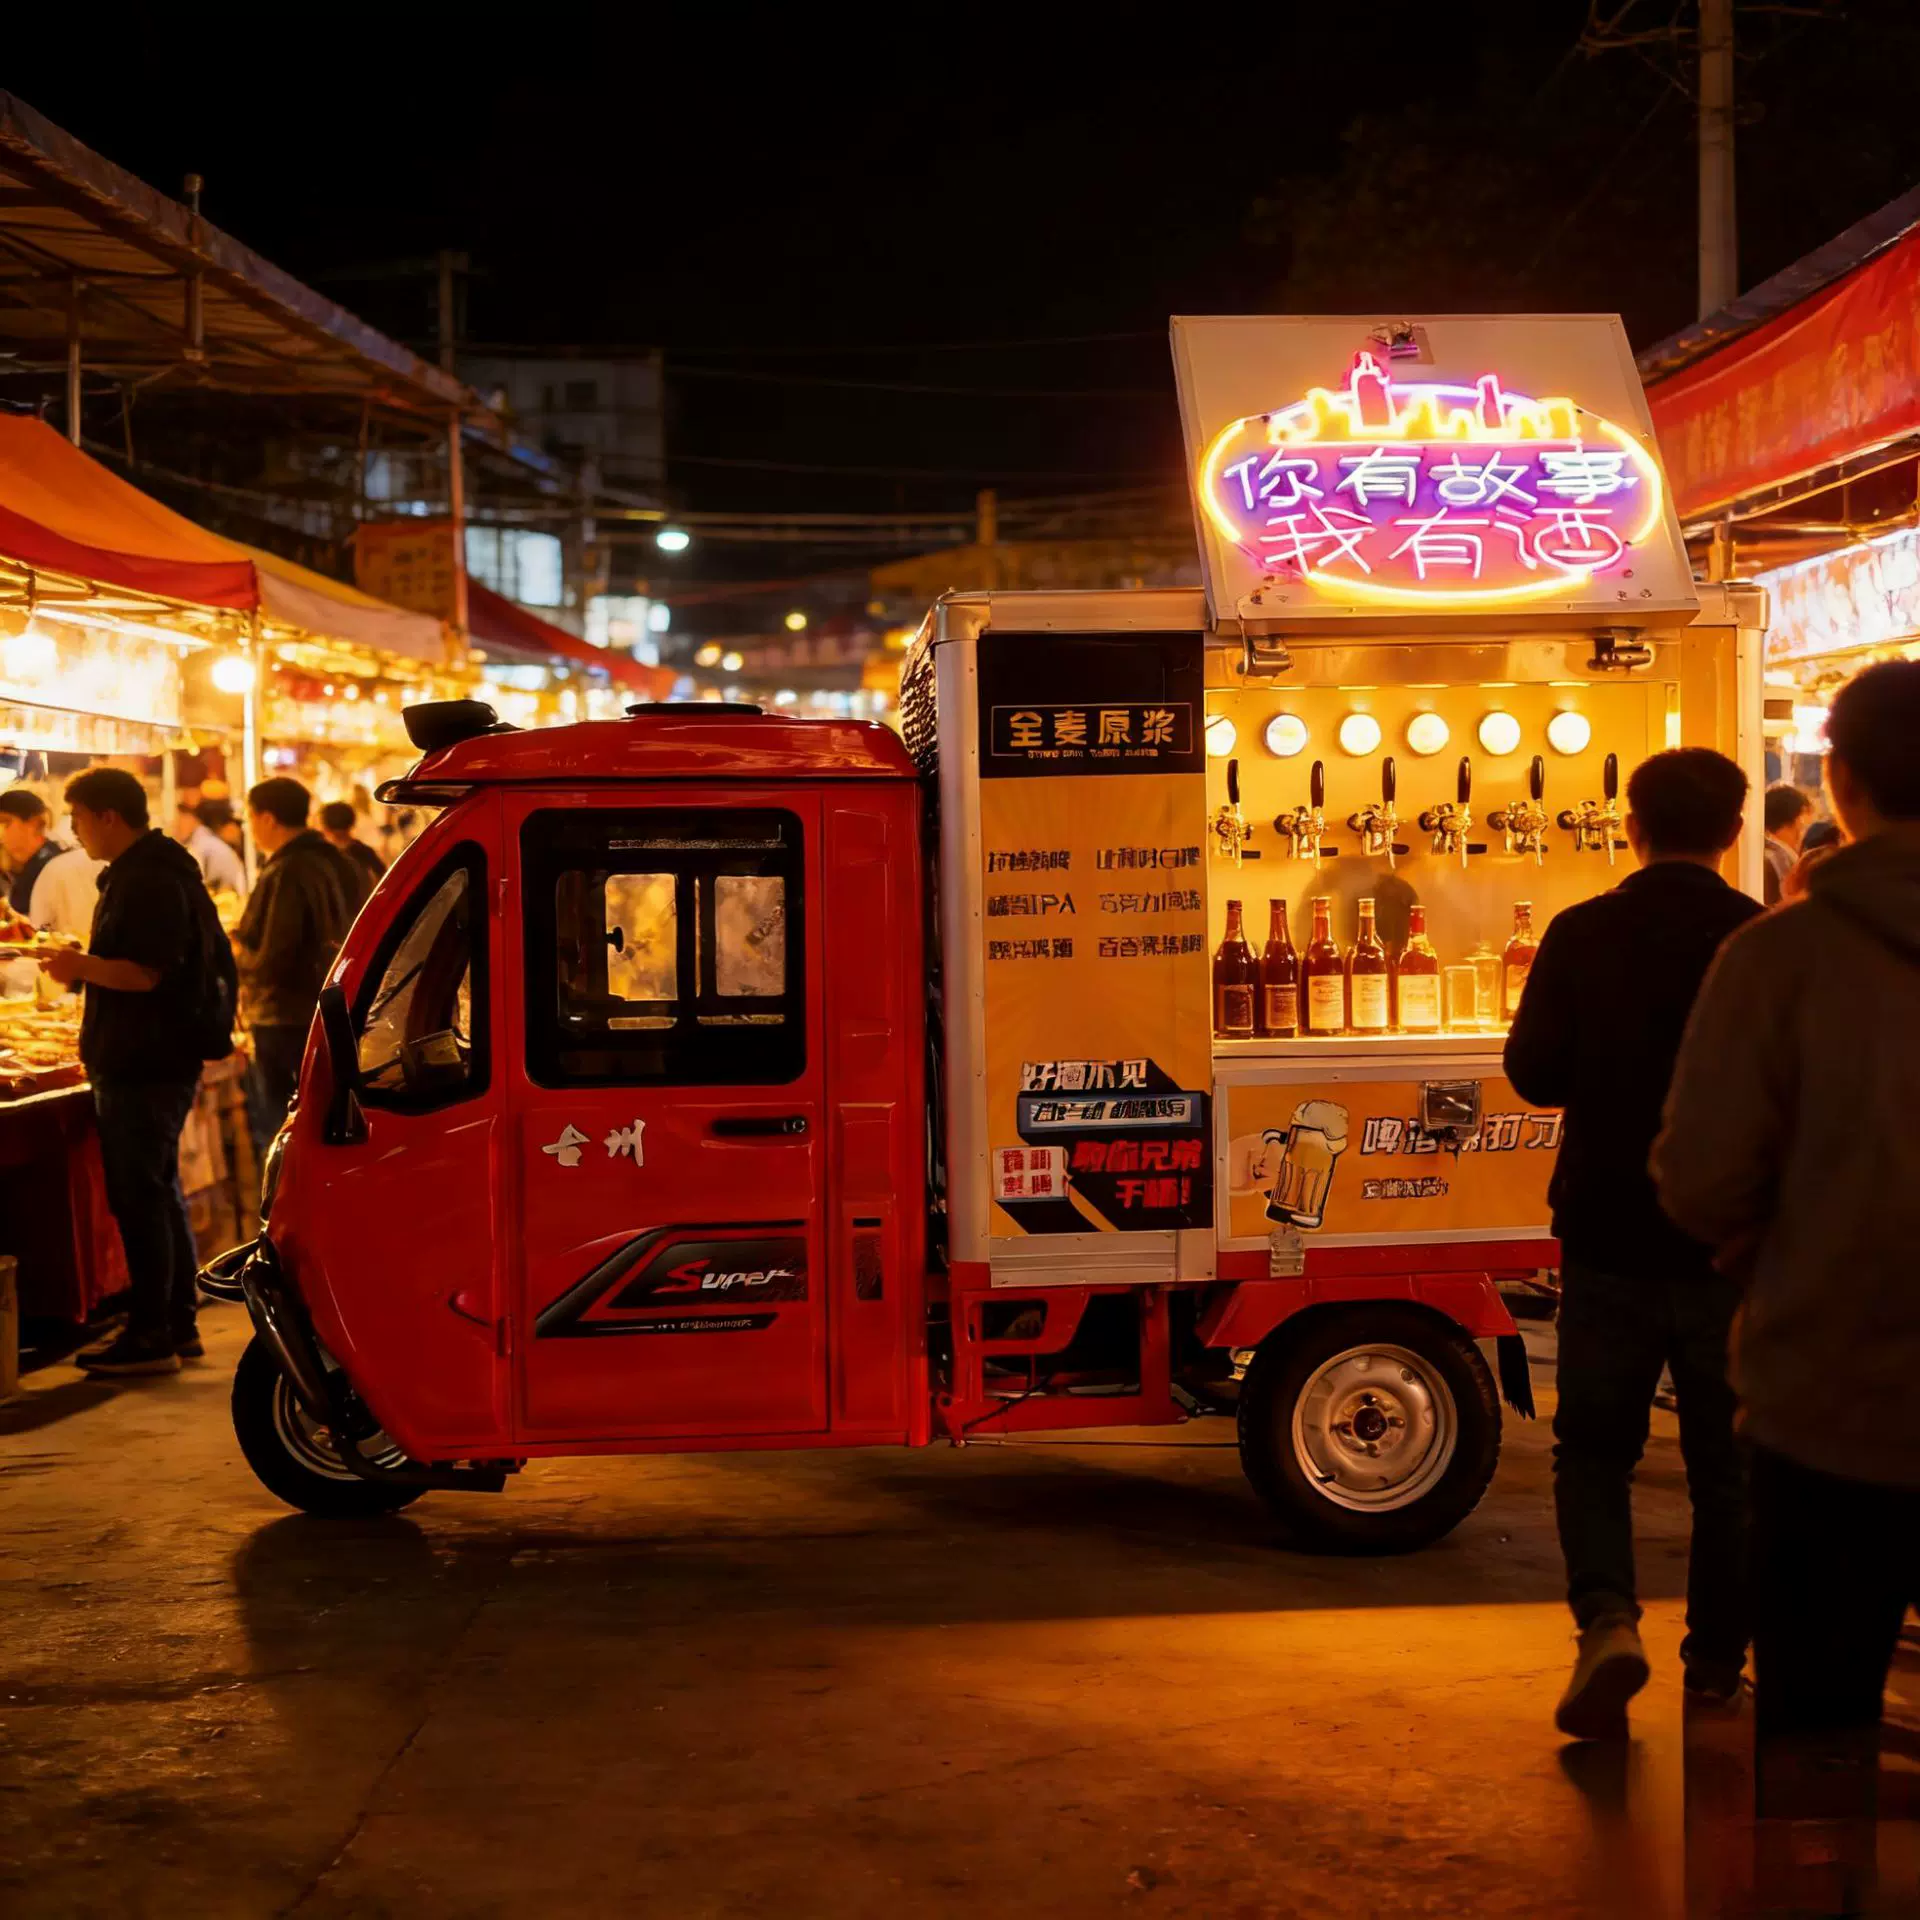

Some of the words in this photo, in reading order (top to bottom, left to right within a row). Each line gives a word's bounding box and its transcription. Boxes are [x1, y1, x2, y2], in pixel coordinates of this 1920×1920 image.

[1223, 445, 1640, 510] 你有故事
[1258, 502, 1624, 581] 我有酒
[1009, 708, 1176, 748] 全麦原浆
